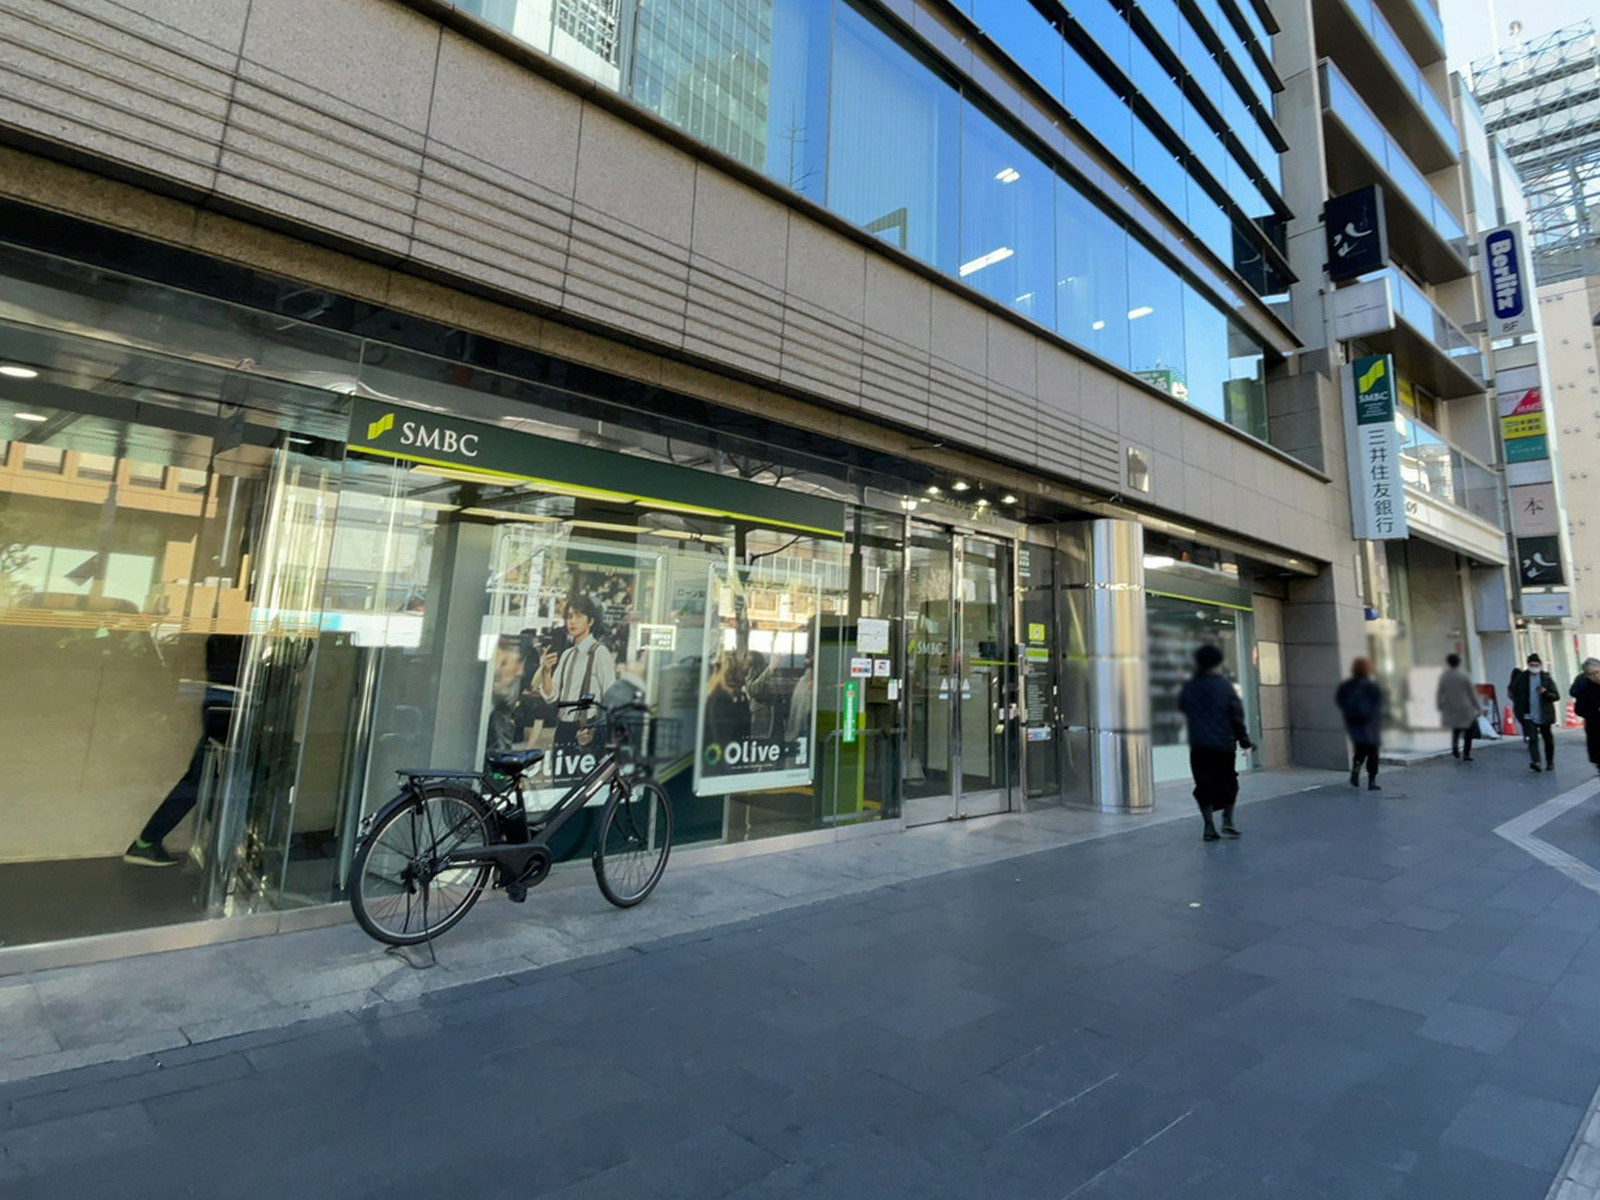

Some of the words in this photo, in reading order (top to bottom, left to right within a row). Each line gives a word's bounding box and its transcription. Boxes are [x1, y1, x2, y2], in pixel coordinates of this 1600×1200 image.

[1490, 238, 1518, 311] Berlitz
[1358, 391, 1389, 404] SMBC
[400, 421, 479, 457] SMBC
[1368, 428, 1394, 534] 三井住友銀行
[916, 640, 943, 656] SMBC
[724, 740, 780, 765] Olive
